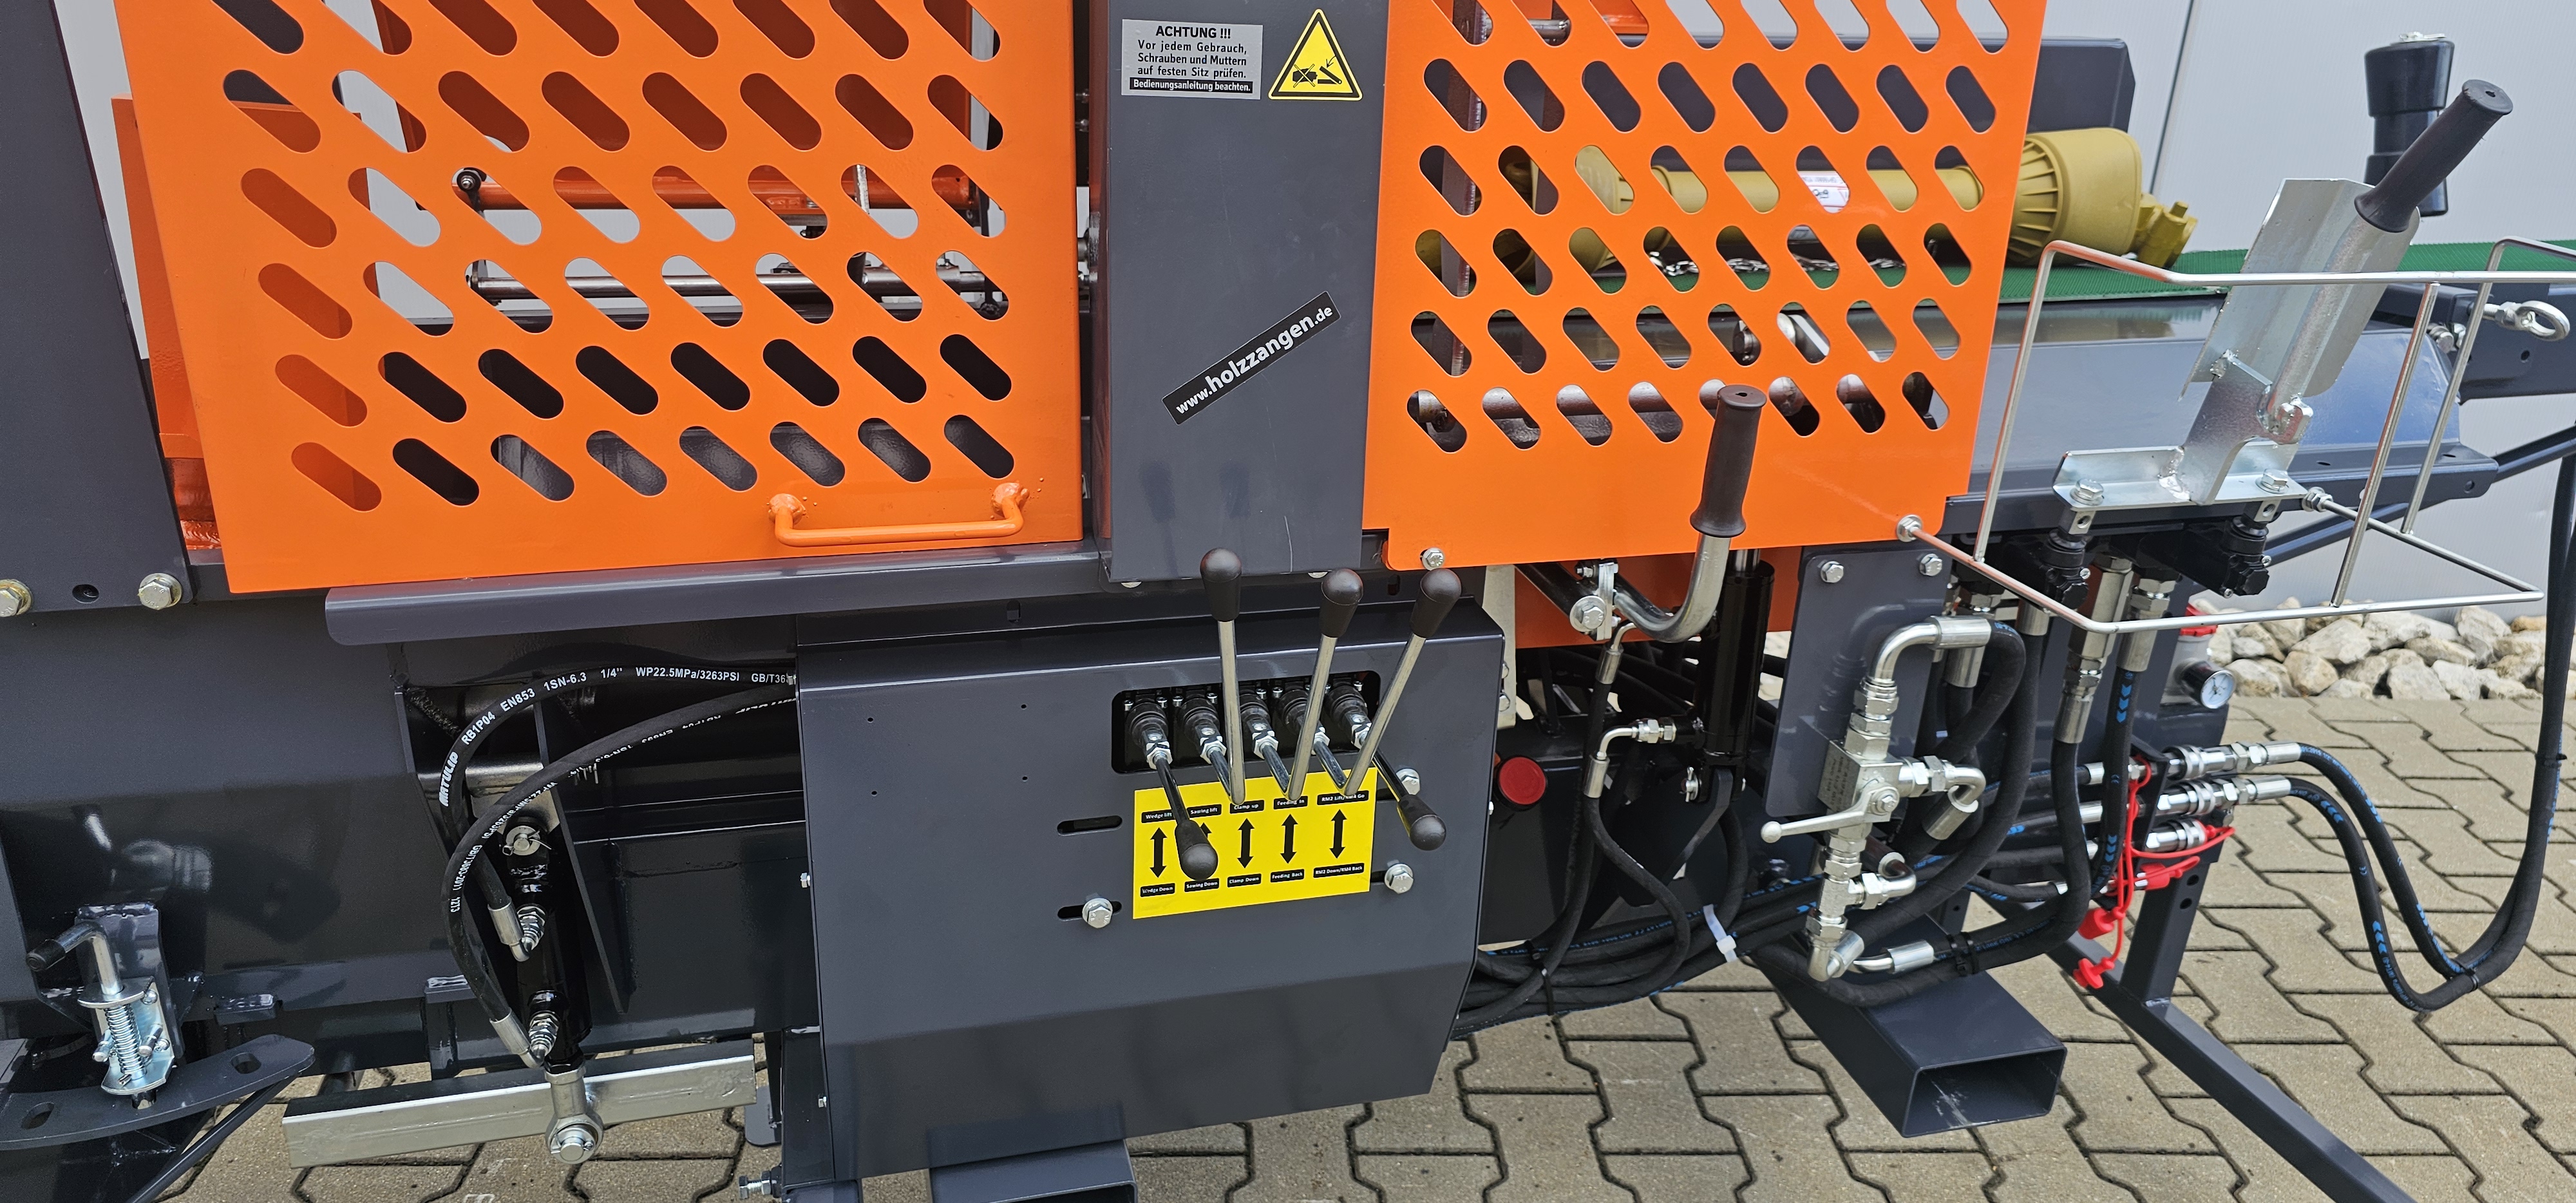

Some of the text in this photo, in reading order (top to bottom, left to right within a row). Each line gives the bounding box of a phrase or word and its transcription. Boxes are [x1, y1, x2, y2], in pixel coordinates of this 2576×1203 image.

[1156, 25, 1231, 39] ACHTUNG !!!
[1138, 39, 1247, 55] Vor jedem Gebrauch,
[1137, 52, 1247, 66] Schrauben und Muttern
[1137, 66, 1246, 79] auf festen Sitz prüfen.
[1133, 79, 1251, 92] Bedienungsanleitung beachten.
[1176, 307, 1332, 414] www.holzzangen.de
[461, 711, 495, 745] RB1P04
[500, 688, 535, 712] EN853
[544, 672, 587, 691] 1SN-6.3
[636, 667, 740, 681] WP22.5MPa/3263PSI
